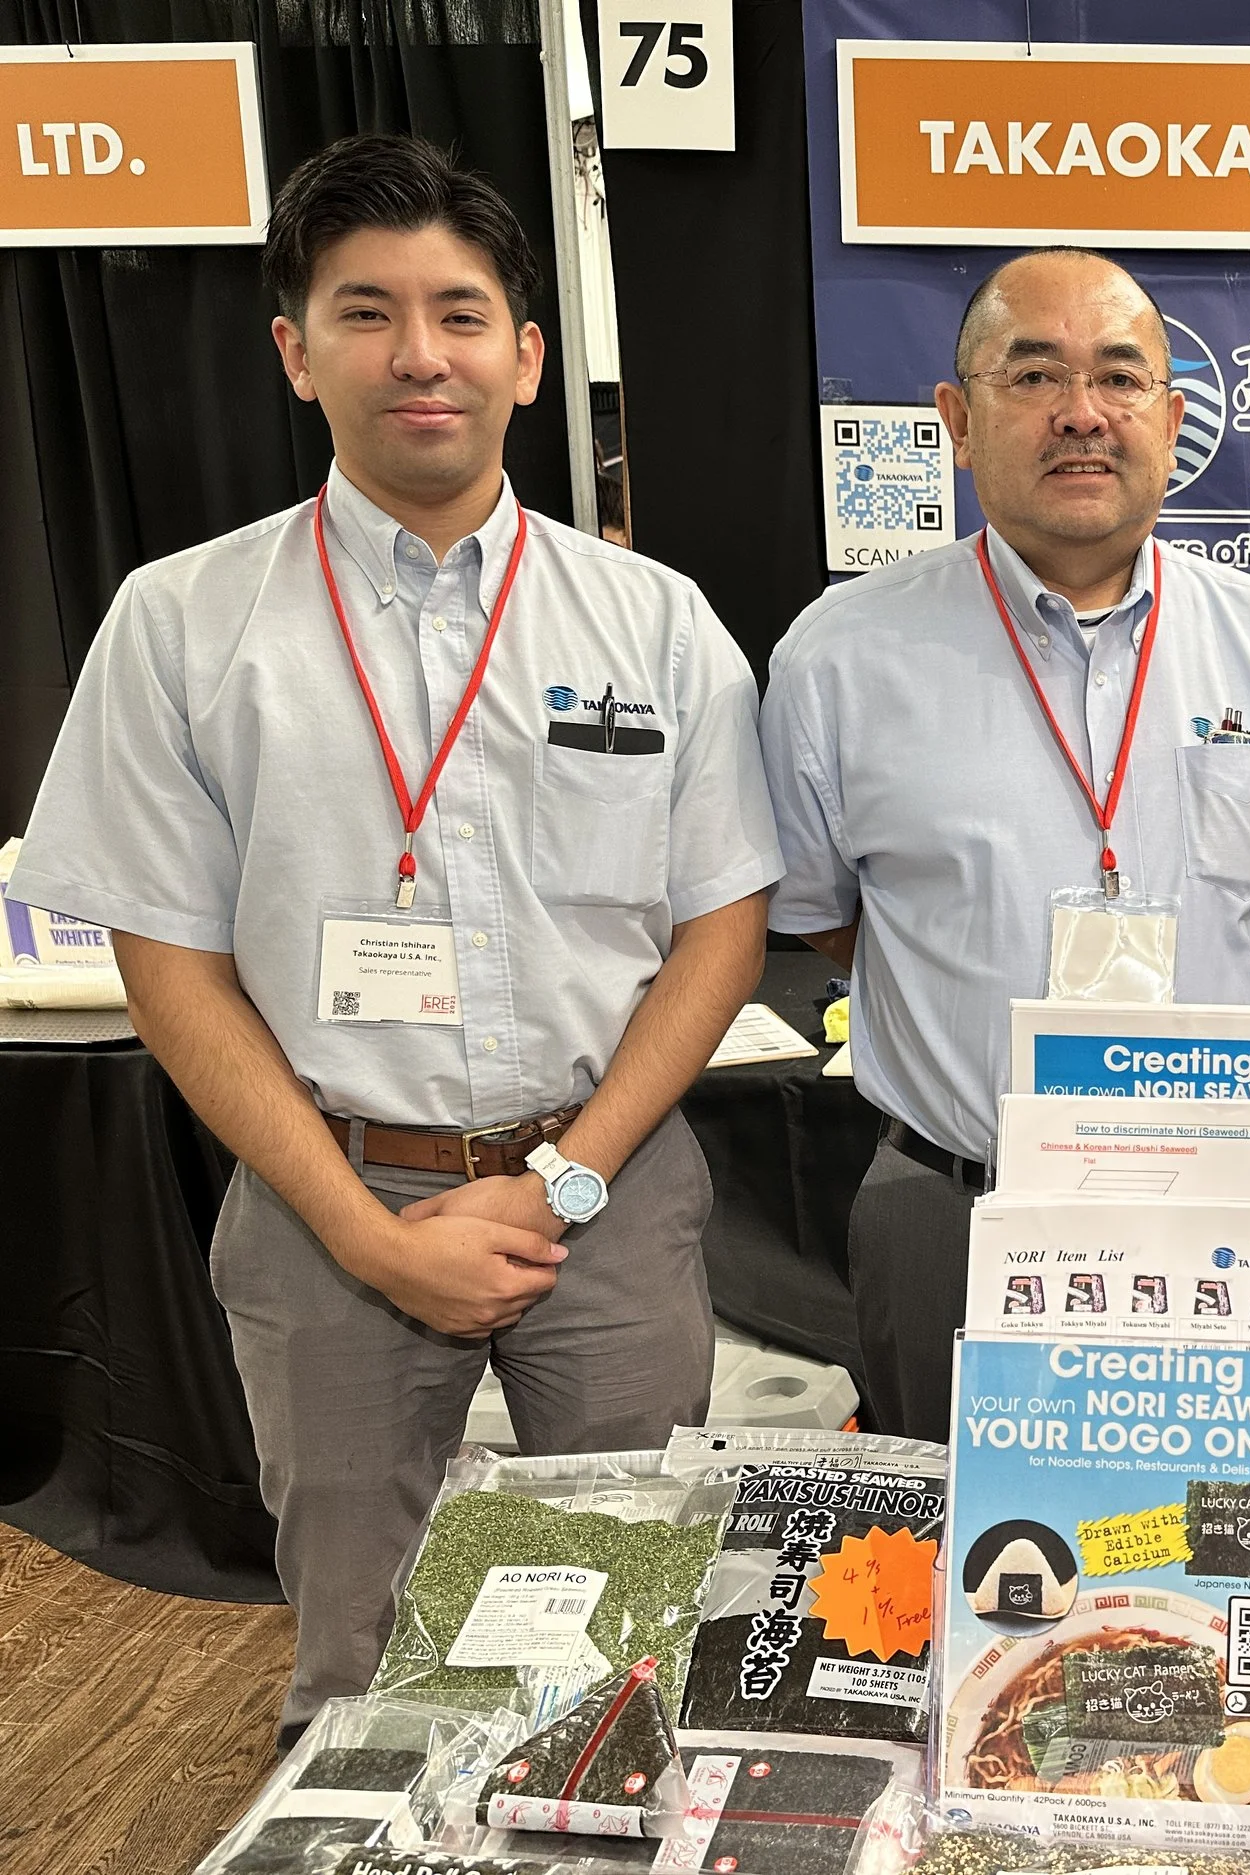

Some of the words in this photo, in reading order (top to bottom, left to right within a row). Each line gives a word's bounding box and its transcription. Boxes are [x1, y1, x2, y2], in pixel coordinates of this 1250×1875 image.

[619, 22, 708, 89] 75
[15, 123, 146, 176] LTD.
[876, 473, 923, 482] TAKAOKAYA
[51, 929, 105, 947] WHITE
[360, 938, 399, 948] Christian
[401, 941, 436, 950] Ishihara
[353, 950, 398, 960] Takaokaya
[358, 966, 378, 974] Sales
[379, 969, 432, 978] representative
[1134, 1080, 1197, 1099] NORI
[1076, 1124, 1098, 1133] How
[1101, 1125, 1111, 1133] to
[1113, 1125, 1174, 1134] discriminate
[1176, 1126, 1196, 1135] Nori
[1199, 1127, 1249, 1138] (Seaweed)
[1040, 1142, 1073, 1150] Chinese
[1083, 1143, 1112, 1151] Korean
[1132, 1144, 1158, 1152] (Sushi
[1160, 1145, 1197, 1154] Seaweed)
[1004, 1251, 1046, 1264] NORI
[1056, 1250, 1087, 1262] Item
[1098, 1249, 1124, 1262] List
[1049, 1343, 1244, 1395] Creating
[970, 1394, 1020, 1415] your
[1027, 1397, 1076, 1415] own
[1087, 1390, 1165, 1418] NORI
[966, 1416, 1069, 1451] YOUR
[1082, 1421, 1192, 1456] LOGO
[1029, 1455, 1046, 1466] for
[1048, 1455, 1092, 1468] Noodle
[1095, 1458, 1133, 1473] shops,
[1136, 1460, 1206, 1474] Restaurants
[1209, 1463, 1218, 1474] &
[1222, 1463, 1250, 1476] Delis
[769, 1466, 847, 1482] ROASTED
[850, 1472, 926, 1490] SEAWEED
[734, 1479, 945, 1519] YAKISUSHINORI
[1201, 1497, 1236, 1510] LUCKY
[734, 1514, 773, 1532] ROLL
[1083, 1524, 1132, 1541] Drawn
[1140, 1513, 1180, 1531] with
[1201, 1522, 1234, 1535] 招き猫
[1105, 1533, 1162, 1552] Edible
[1103, 1548, 1171, 1568] Calcium
[499, 1573, 522, 1583] AO
[525, 1571, 562, 1583] NORI
[564, 1572, 587, 1584] KO
[1194, 1579, 1241, 1589] Japanese
[741, 1509, 836, 1700] 焼寿司海苔
[896, 1607, 931, 1631] Free
[820, 1662, 836, 1672] NET
[838, 1664, 871, 1676] WEIGHT
[872, 1668, 891, 1678] 3.75
[893, 1671, 906, 1680] OZ
[1081, 1668, 1121, 1683] LUCKY
[1123, 1665, 1146, 1679] CAT
[1153, 1664, 1194, 1676] Ramen
[843, 1688, 889, 1698] TAKAOKAYA
[852, 1677, 867, 1686] 100
[869, 1680, 899, 1691] SHEETS
[1171, 1689, 1200, 1700] ラーメン
[1085, 1697, 1123, 1713] 招き猫
[944, 1791, 985, 1801] Minimum
[987, 1793, 1025, 1803] Quantity
[1033, 1796, 1065, 1805] 42Pack
[1075, 1797, 1107, 1808] 600pcs
[1053, 1813, 1105, 1824] TAKAOKAYA
